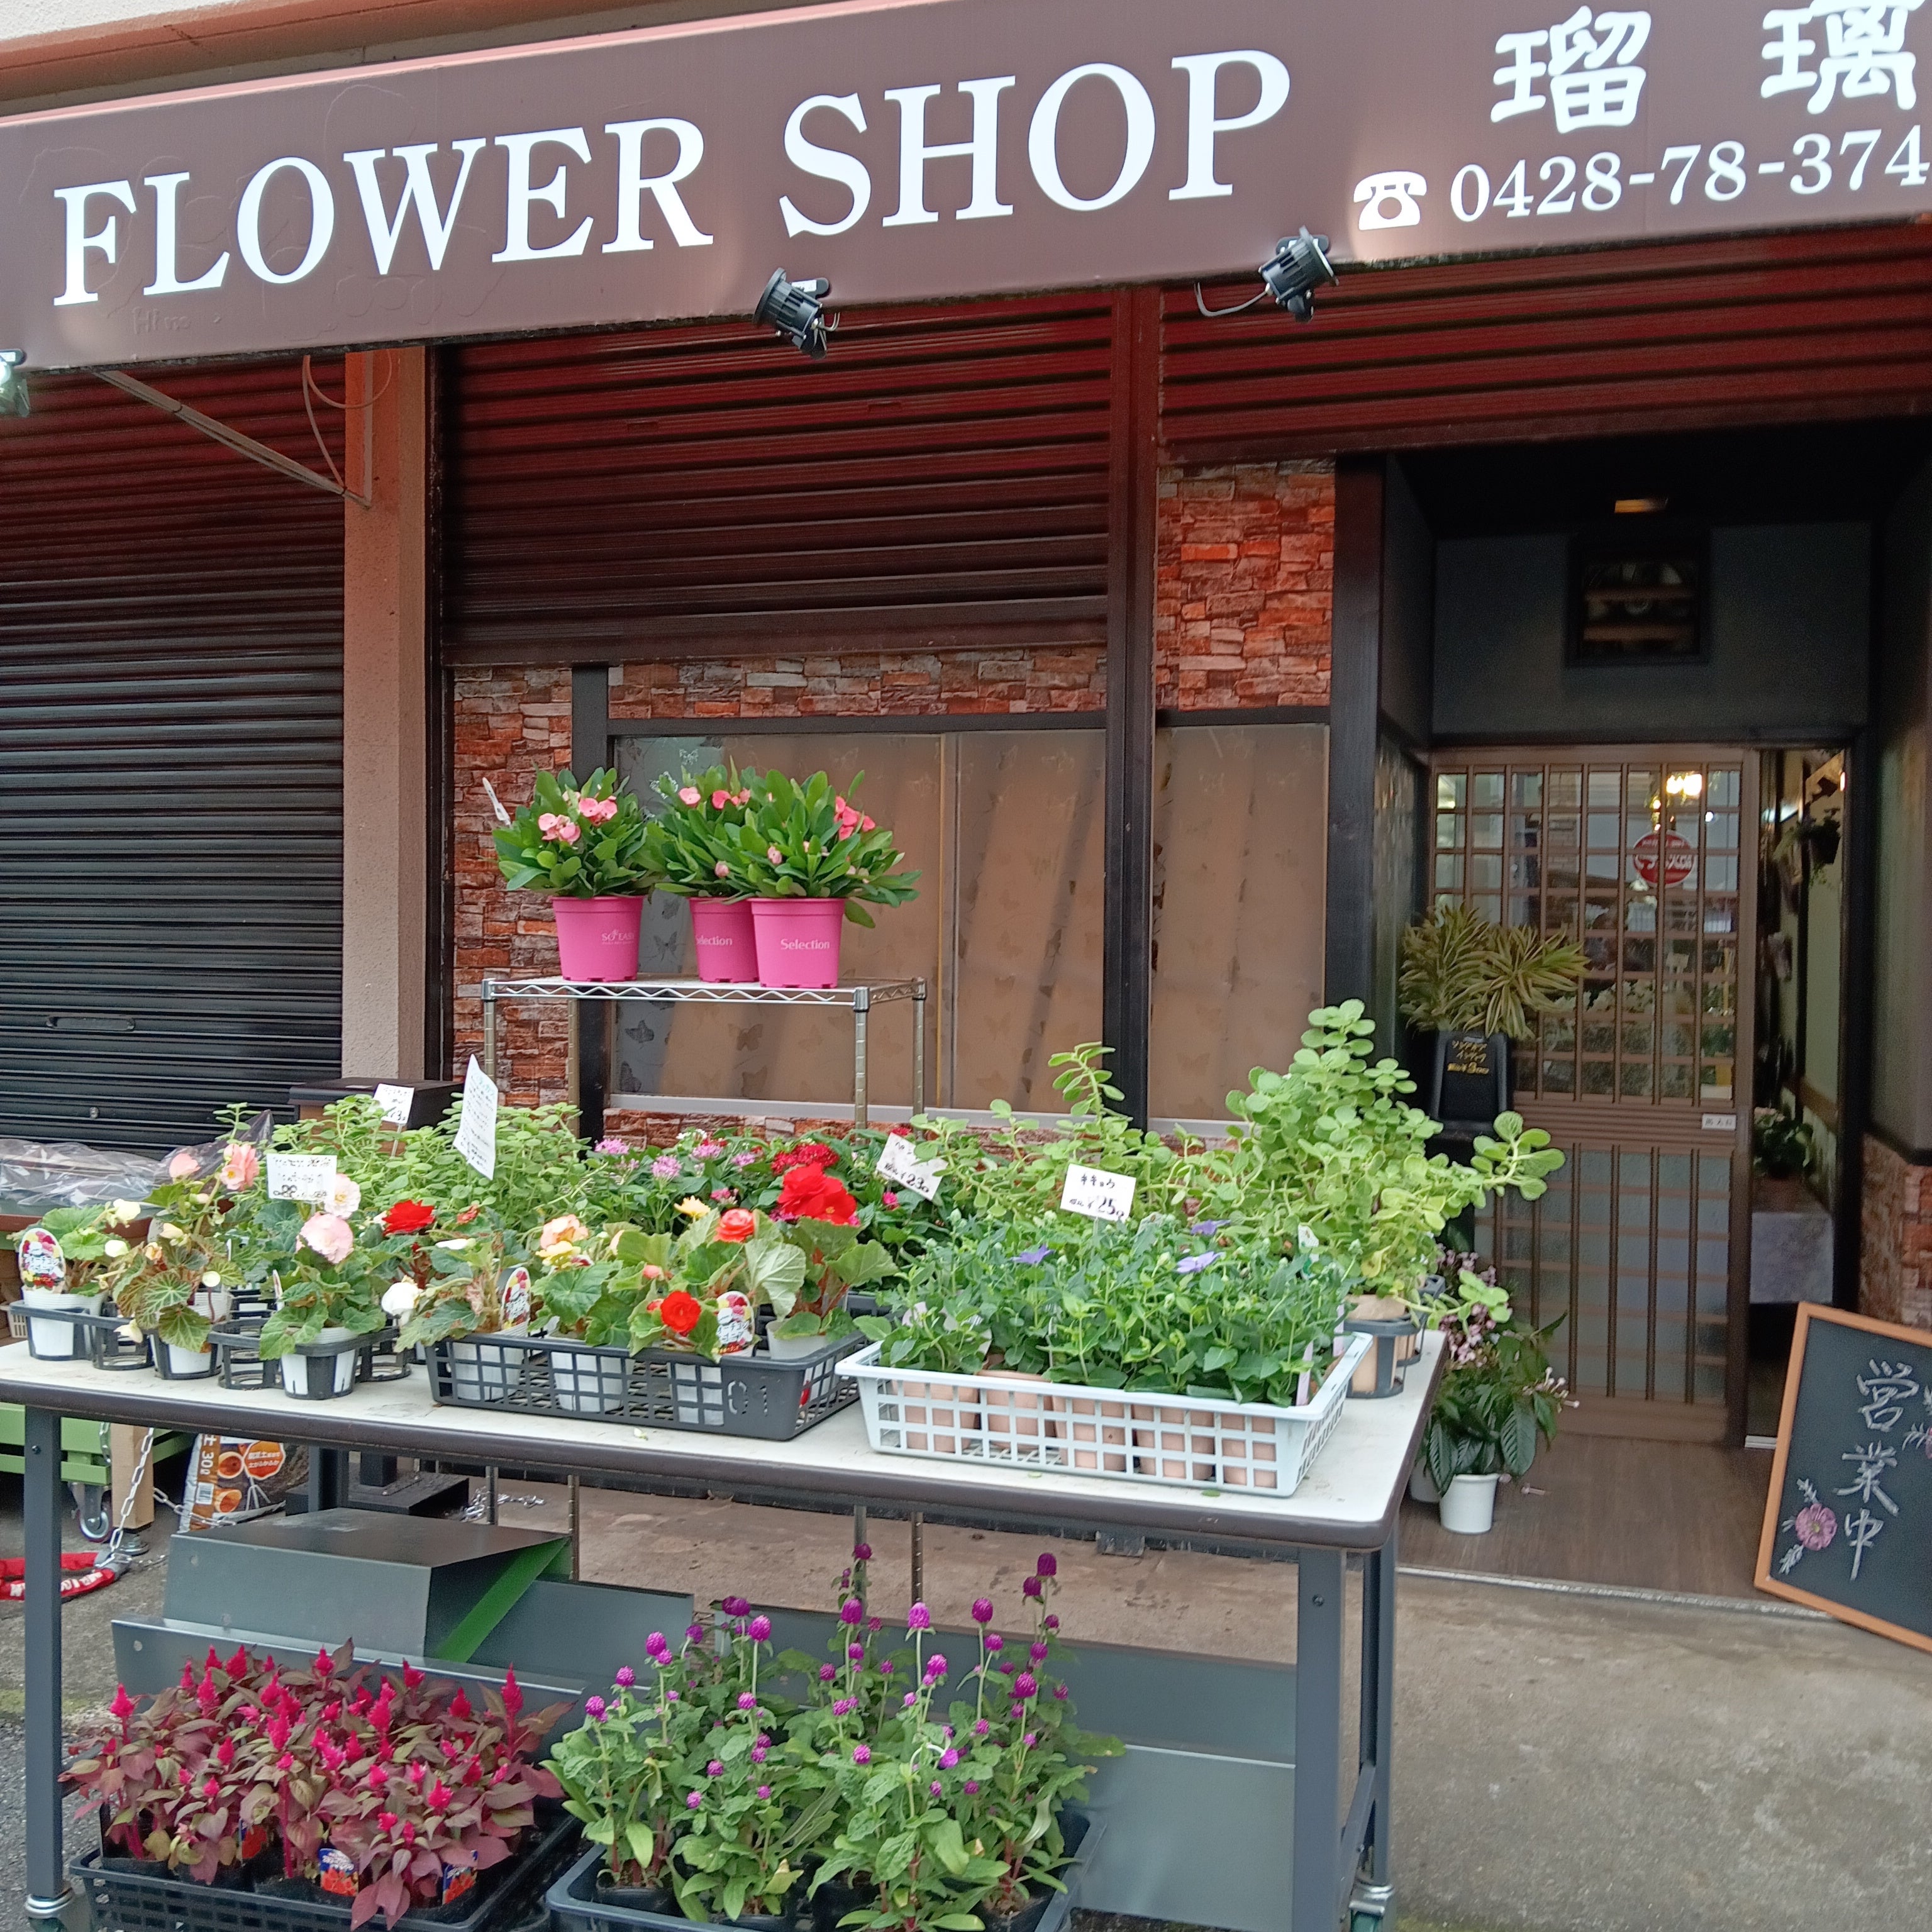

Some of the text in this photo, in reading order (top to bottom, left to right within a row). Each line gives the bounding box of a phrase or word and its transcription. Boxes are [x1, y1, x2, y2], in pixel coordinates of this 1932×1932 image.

[53, 50, 1291, 306] FLOWER SHOP
[1450, 125, 1931, 222] 0428-78-374
[780, 938, 830, 950] Selection
[1831, 1359, 1920, 1582] 営業中
